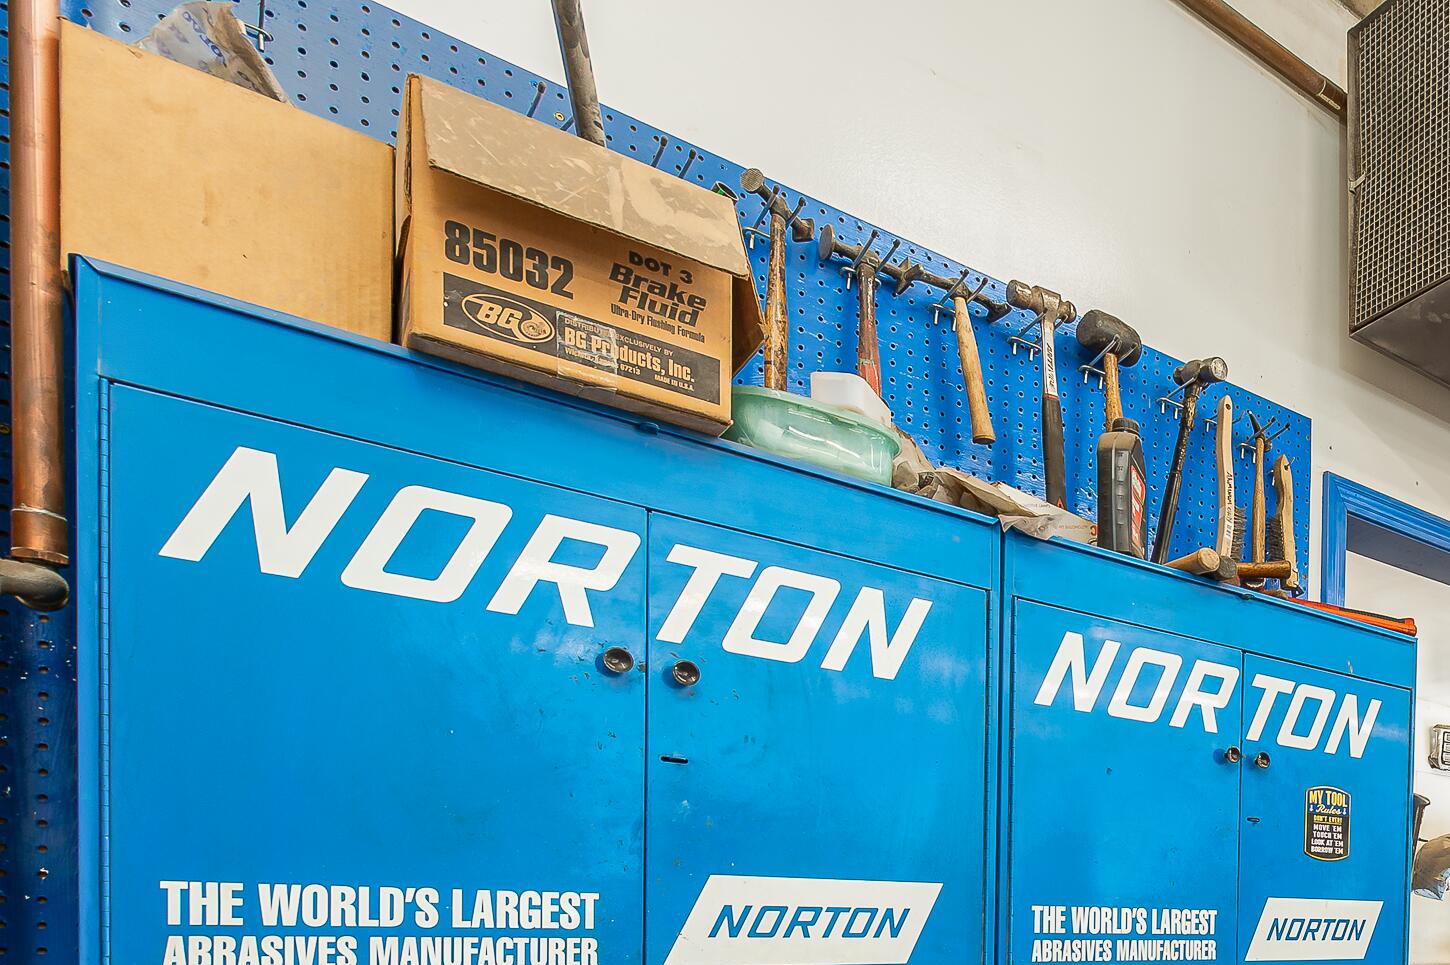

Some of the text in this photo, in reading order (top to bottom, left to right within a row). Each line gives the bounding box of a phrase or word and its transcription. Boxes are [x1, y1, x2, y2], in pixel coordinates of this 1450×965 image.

[444, 219, 574, 300] 85032
[629, 250, 693, 285] DOT 3
[609, 263, 707, 312] Brake
[618, 284, 700, 328] Fluid
[611, 303, 706, 344] Ultra-Dry Flushing Formula
[564, 327, 587, 350] BG
[668, 359, 695, 383] Inc.
[663, 348, 674, 357] BY
[158, 446, 933, 680] NORTON
[1033, 631, 1381, 760] NORTON
[1309, 790, 1347, 807] MY TOOL
[1316, 804, 1341, 815] Rules
[160, 881, 599, 930] THE WORLD'S LARGEST
[708, 905, 910, 940] NORTON
[1032, 905, 1218, 936] THE WORLD'S LARGEST
[1266, 917, 1367, 942] NORTON
[1032, 937, 1218, 963] ABRASIVES MANUFACTURER
